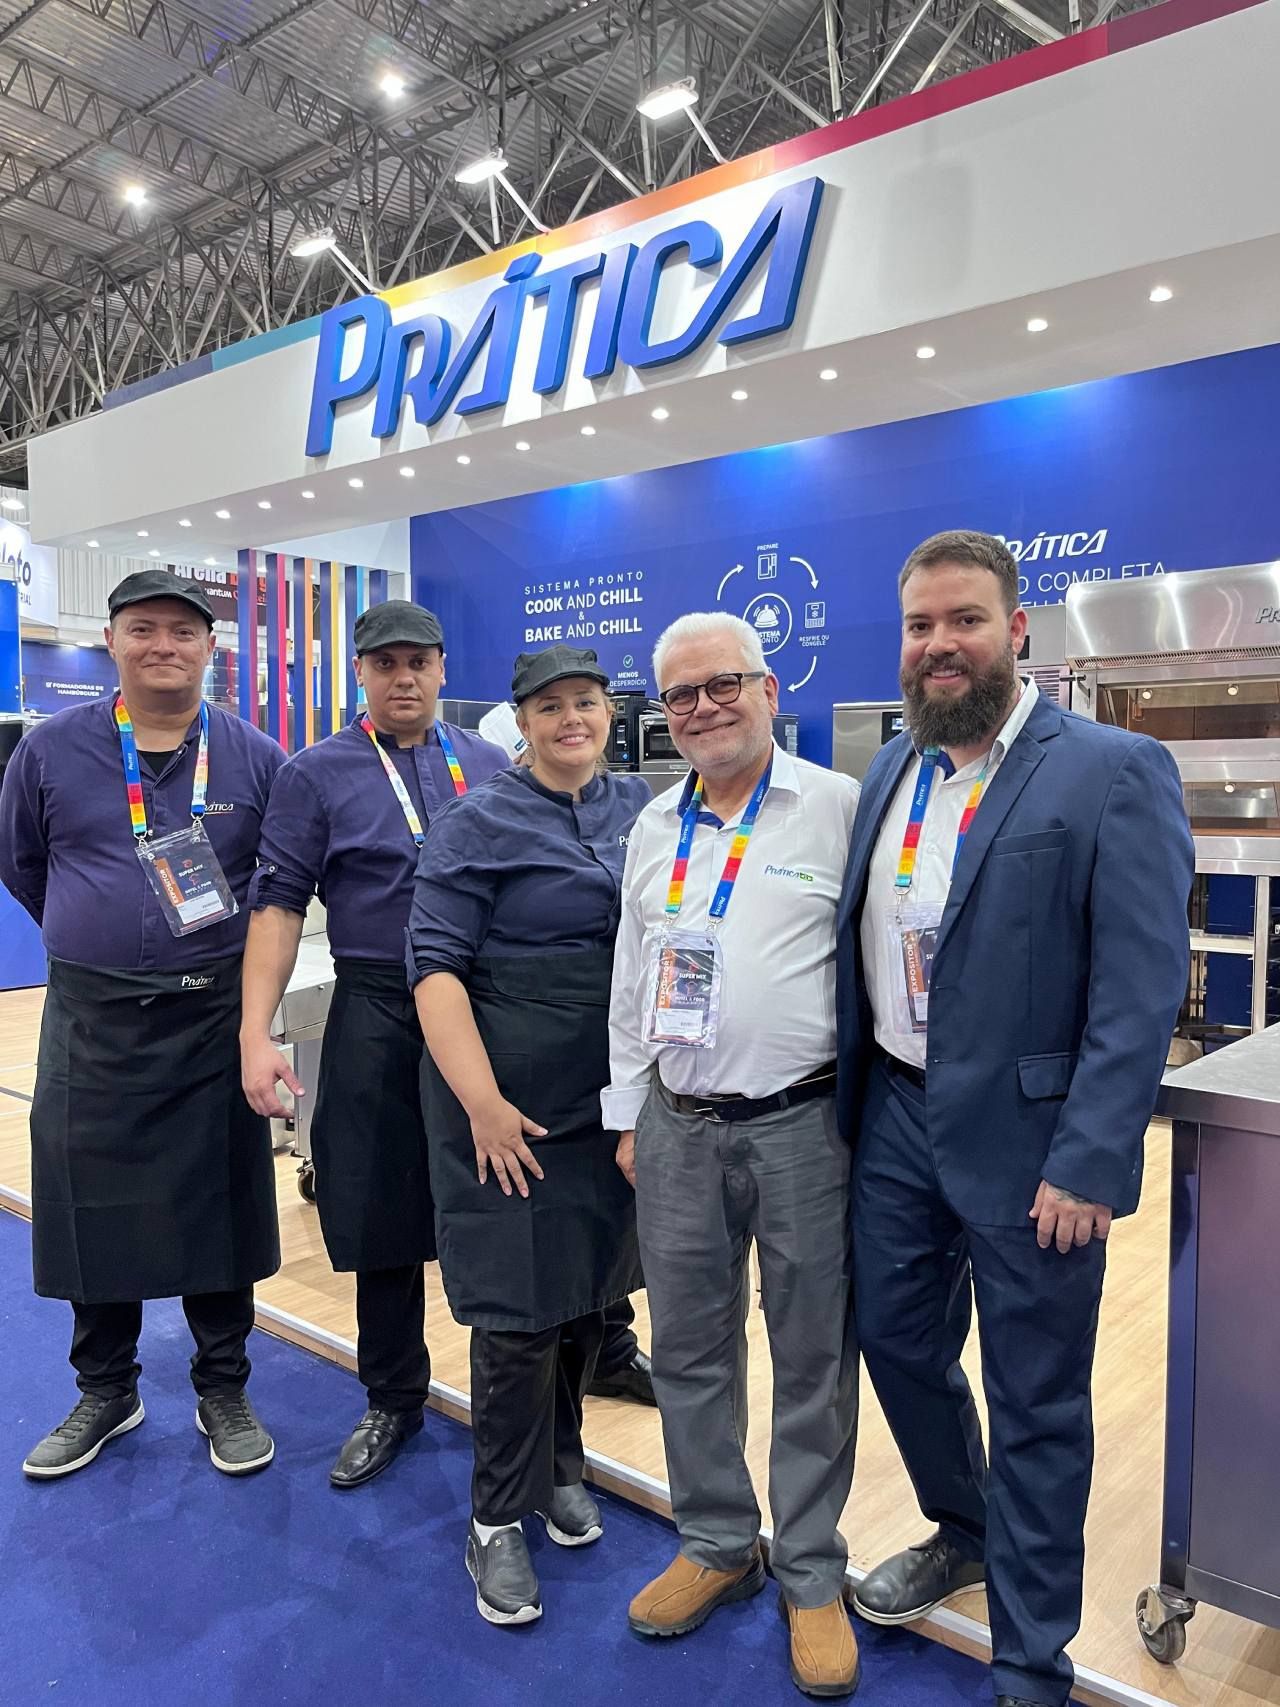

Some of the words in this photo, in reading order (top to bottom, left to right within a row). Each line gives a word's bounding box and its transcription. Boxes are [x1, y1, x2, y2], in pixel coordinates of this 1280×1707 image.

[305, 176, 823, 457] PRÁTICA
[524, 579, 580, 596] SISTEMA
[589, 570, 643, 586] PRONTO
[525, 597, 564, 615] COOK
[566, 593, 596, 610] AND
[600, 587, 643, 606] CHILL
[578, 611, 585, 621] &
[525, 625, 562, 643] BAKE
[566, 622, 596, 639] AND
[600, 617, 643, 635] CHILL
[762, 636, 779, 644] ONTO
[617, 671, 639, 679] MENOS
[907, 944, 919, 993] EXPOSITOR
